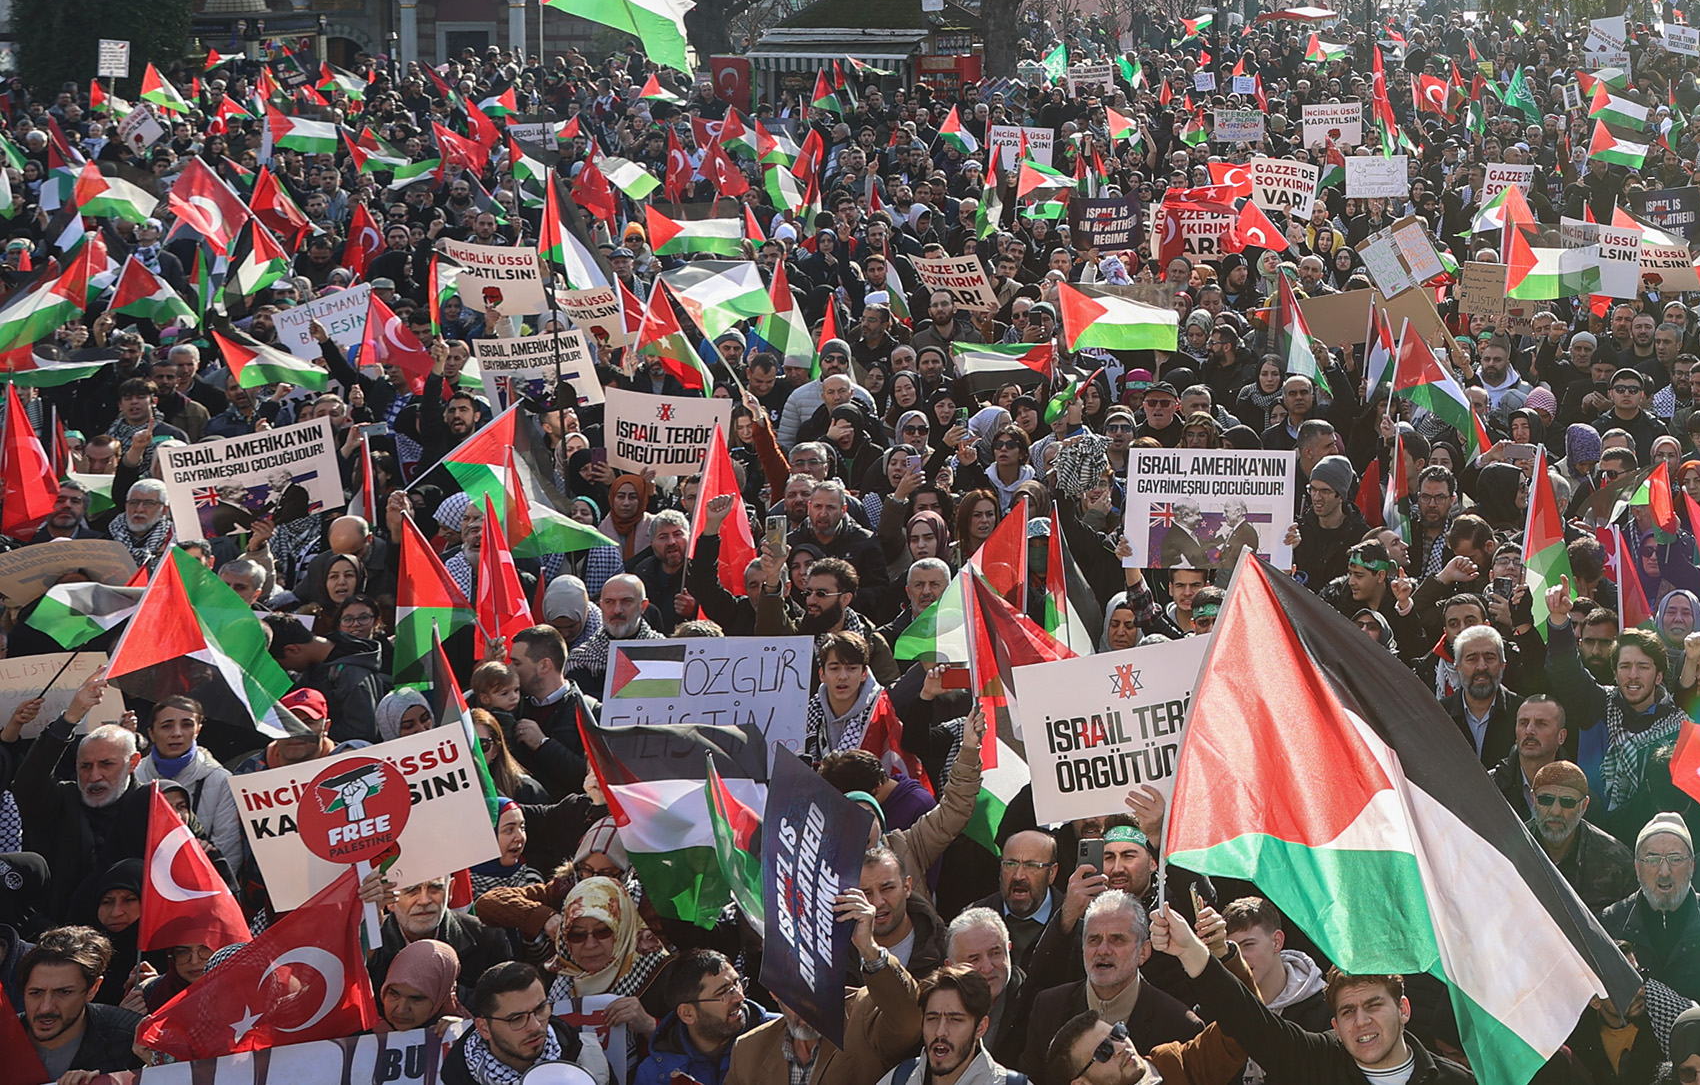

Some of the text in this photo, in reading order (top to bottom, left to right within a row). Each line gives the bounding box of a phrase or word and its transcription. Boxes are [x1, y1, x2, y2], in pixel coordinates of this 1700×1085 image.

[1683, 36, 1696, 44] TERÖR
[1305, 116, 1360, 125] KAPATILSIN!
[1031, 131, 1050, 140] ÜSSÜ
[1255, 164, 1315, 181] GAZZE'DE
[1255, 176, 1314, 194] SOYKIRIM
[1262, 189, 1307, 211] VAR!
[1646, 199, 1681, 212] ISRAEL IS
[1086, 205, 1128, 219] ISRAEL IS
[1078, 220, 1090, 232] AN
[1562, 224, 1638, 247] İNCİRLİK ÜSSÜ
[1093, 232, 1129, 245] REGIME
[1182, 237, 1221, 255] AR!
[449, 247, 534, 267] İNCİRLİK ÜSSÜ
[1655, 250, 1686, 258] ÜSSÜ
[463, 267, 537, 282] APATILSIN!
[921, 272, 984, 286] SOYKIRIM
[584, 291, 613, 305] ÜSSÜ
[481, 338, 509, 359] İSRAİL,
[483, 357, 529, 371] GAYRİMEŞRU
[617, 418, 660, 445] İSRAİL
[169, 448, 222, 471] İSRAİL,
[174, 444, 326, 484] GAYRİMEŞRU ÇOCUĞUDUR!
[1137, 452, 1187, 478] İSRAİL,
[1137, 478, 1284, 498] GAYRİMEŞRU ÇOCUĞUDUR!
[683, 646, 811, 698] ÖZGÜR
[1045, 707, 1132, 754] İSRAİL
[327, 814, 391, 848] FREE
[329, 832, 394, 858] PALESTINE
[776, 817, 797, 948] ISRAEL IS
[796, 801, 825, 994] AN APARTHEID
[816, 859, 840, 968] REGIME
